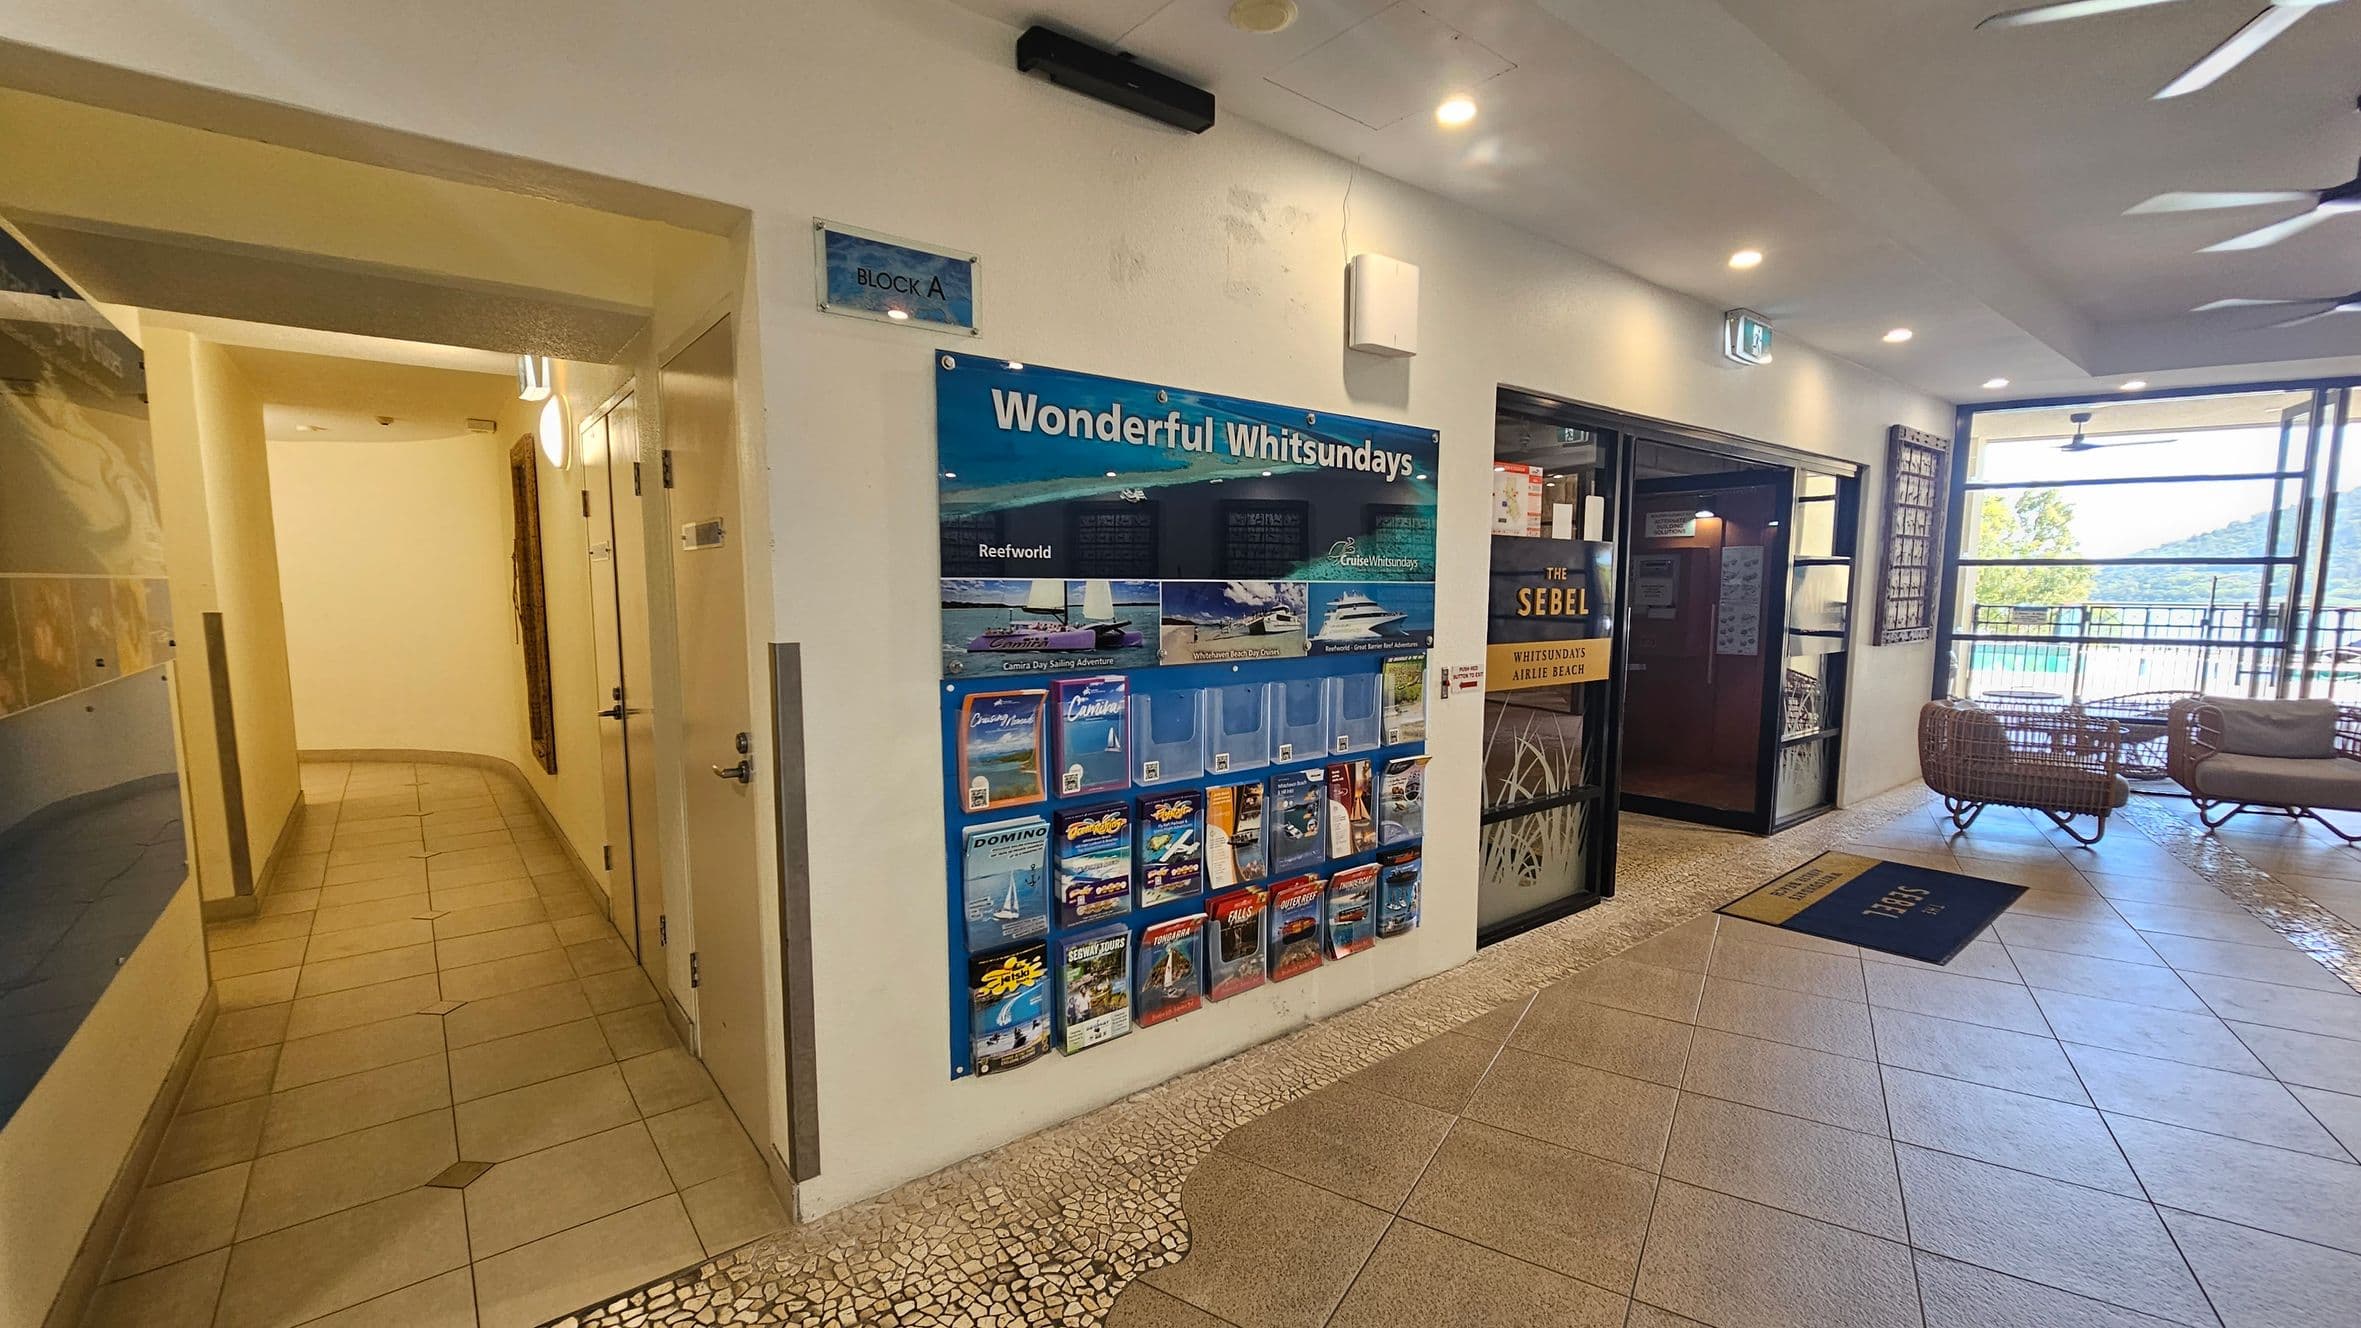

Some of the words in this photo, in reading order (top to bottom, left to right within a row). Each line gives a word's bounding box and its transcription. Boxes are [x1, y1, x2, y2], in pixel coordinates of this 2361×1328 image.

[857, 267, 921, 297] BLOCK
[927, 275, 946, 300] A
[991, 388, 1214, 453] Wonderful
[1226, 421, 1414, 482] Whitsundays
[979, 543, 1052, 559] Reefworld
[1546, 567, 1568, 580] THE
[1517, 587, 1589, 616] SEBEL
[1193, 651, 1229, 660] Whitehaven
[1230, 650, 1248, 658] Beach
[1248, 649, 1260, 658] Day
[1260, 648, 1280, 656] Cruises
[1354, 643, 1367, 651] Great
[1367, 642, 1383, 650] Barrier
[1383, 641, 1394, 649] Reef
[1514, 647, 1586, 663] WHITSUNDAYS
[1003, 661, 1031, 671] Camira
[1033, 660, 1048, 671] Day
[1049, 658, 1075, 669] Sailing
[1077, 657, 1114, 667] Adventure
[1513, 667, 1548, 681] AIRLIE
[1552, 664, 1585, 677] BEACH
[973, 827, 1048, 849] DOMINO
[1280, 895, 1302, 910] OUTER
[1300, 890, 1318, 905] REEF
[1862, 885, 1931, 919] SEBEL
[1228, 905, 1253, 925] FALLS
[1068, 943, 1099, 962] SEGWAY
[1099, 937, 1126, 953] TOURS
